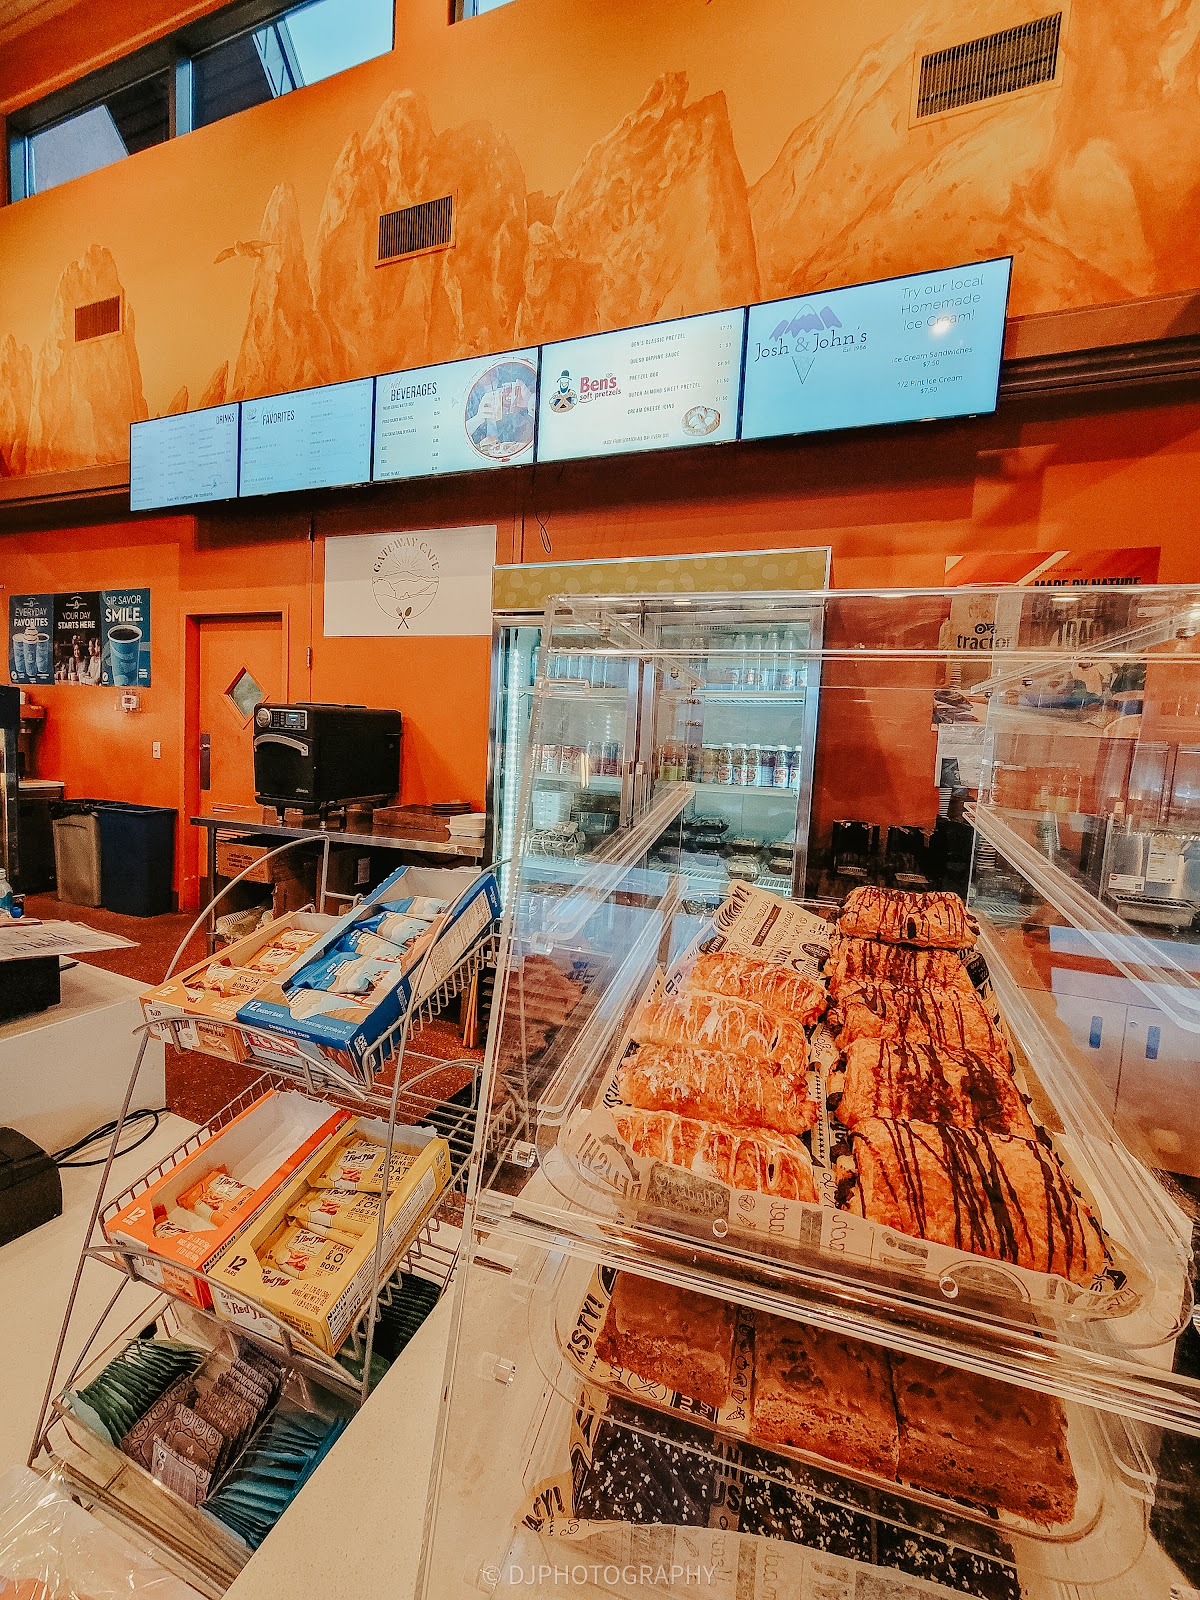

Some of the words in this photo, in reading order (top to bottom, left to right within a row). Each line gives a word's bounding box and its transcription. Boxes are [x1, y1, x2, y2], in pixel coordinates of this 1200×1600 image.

[901, 287, 921, 301] Try
[924, 282, 947, 295] our
[950, 274, 985, 291] local
[901, 292, 982, 315] Homemade
[903, 318, 923, 331] Ice
[925, 309, 976, 328] Cream!
[754, 337, 790, 363] Josh
[794, 336, 811, 353] &
[812, 325, 868, 353] John's
[905, 352, 928, 362] Cream
[929, 346, 973, 359] Sandwiches
[922, 359, 940, 368] $7.50
[926, 377, 938, 385] Ice
[939, 373, 963, 383] Cream
[390, 382, 438, 402] BEVERAGES
[579, 392, 593, 402] soft
[594, 388, 622, 402] pretzels
[214, 412, 235, 426] DRINKS
[261, 408, 296, 426] FAVORITES
[373, 537, 419, 573] GATEWAY
[15, 608, 47, 617] EVERYDAY
[62, 612, 78, 620] YOUR
[80, 611, 91, 620] DAY
[105, 608, 144, 623] SMILE.
[14, 618, 48, 627] FAVORITES
[58, 621, 79, 630] STARTS
[80, 620, 96, 629] HERE
[716, 885, 752, 934] YUMMY!
[246, 1002, 262, 1012] 12
[130, 1207, 147, 1222] 12
[202, 1234, 237, 1270] Nutrition
[227, 1254, 248, 1272] 12
[223, 1267, 238, 1277] BARS
[326, 1282, 356, 1321] Nutrition
